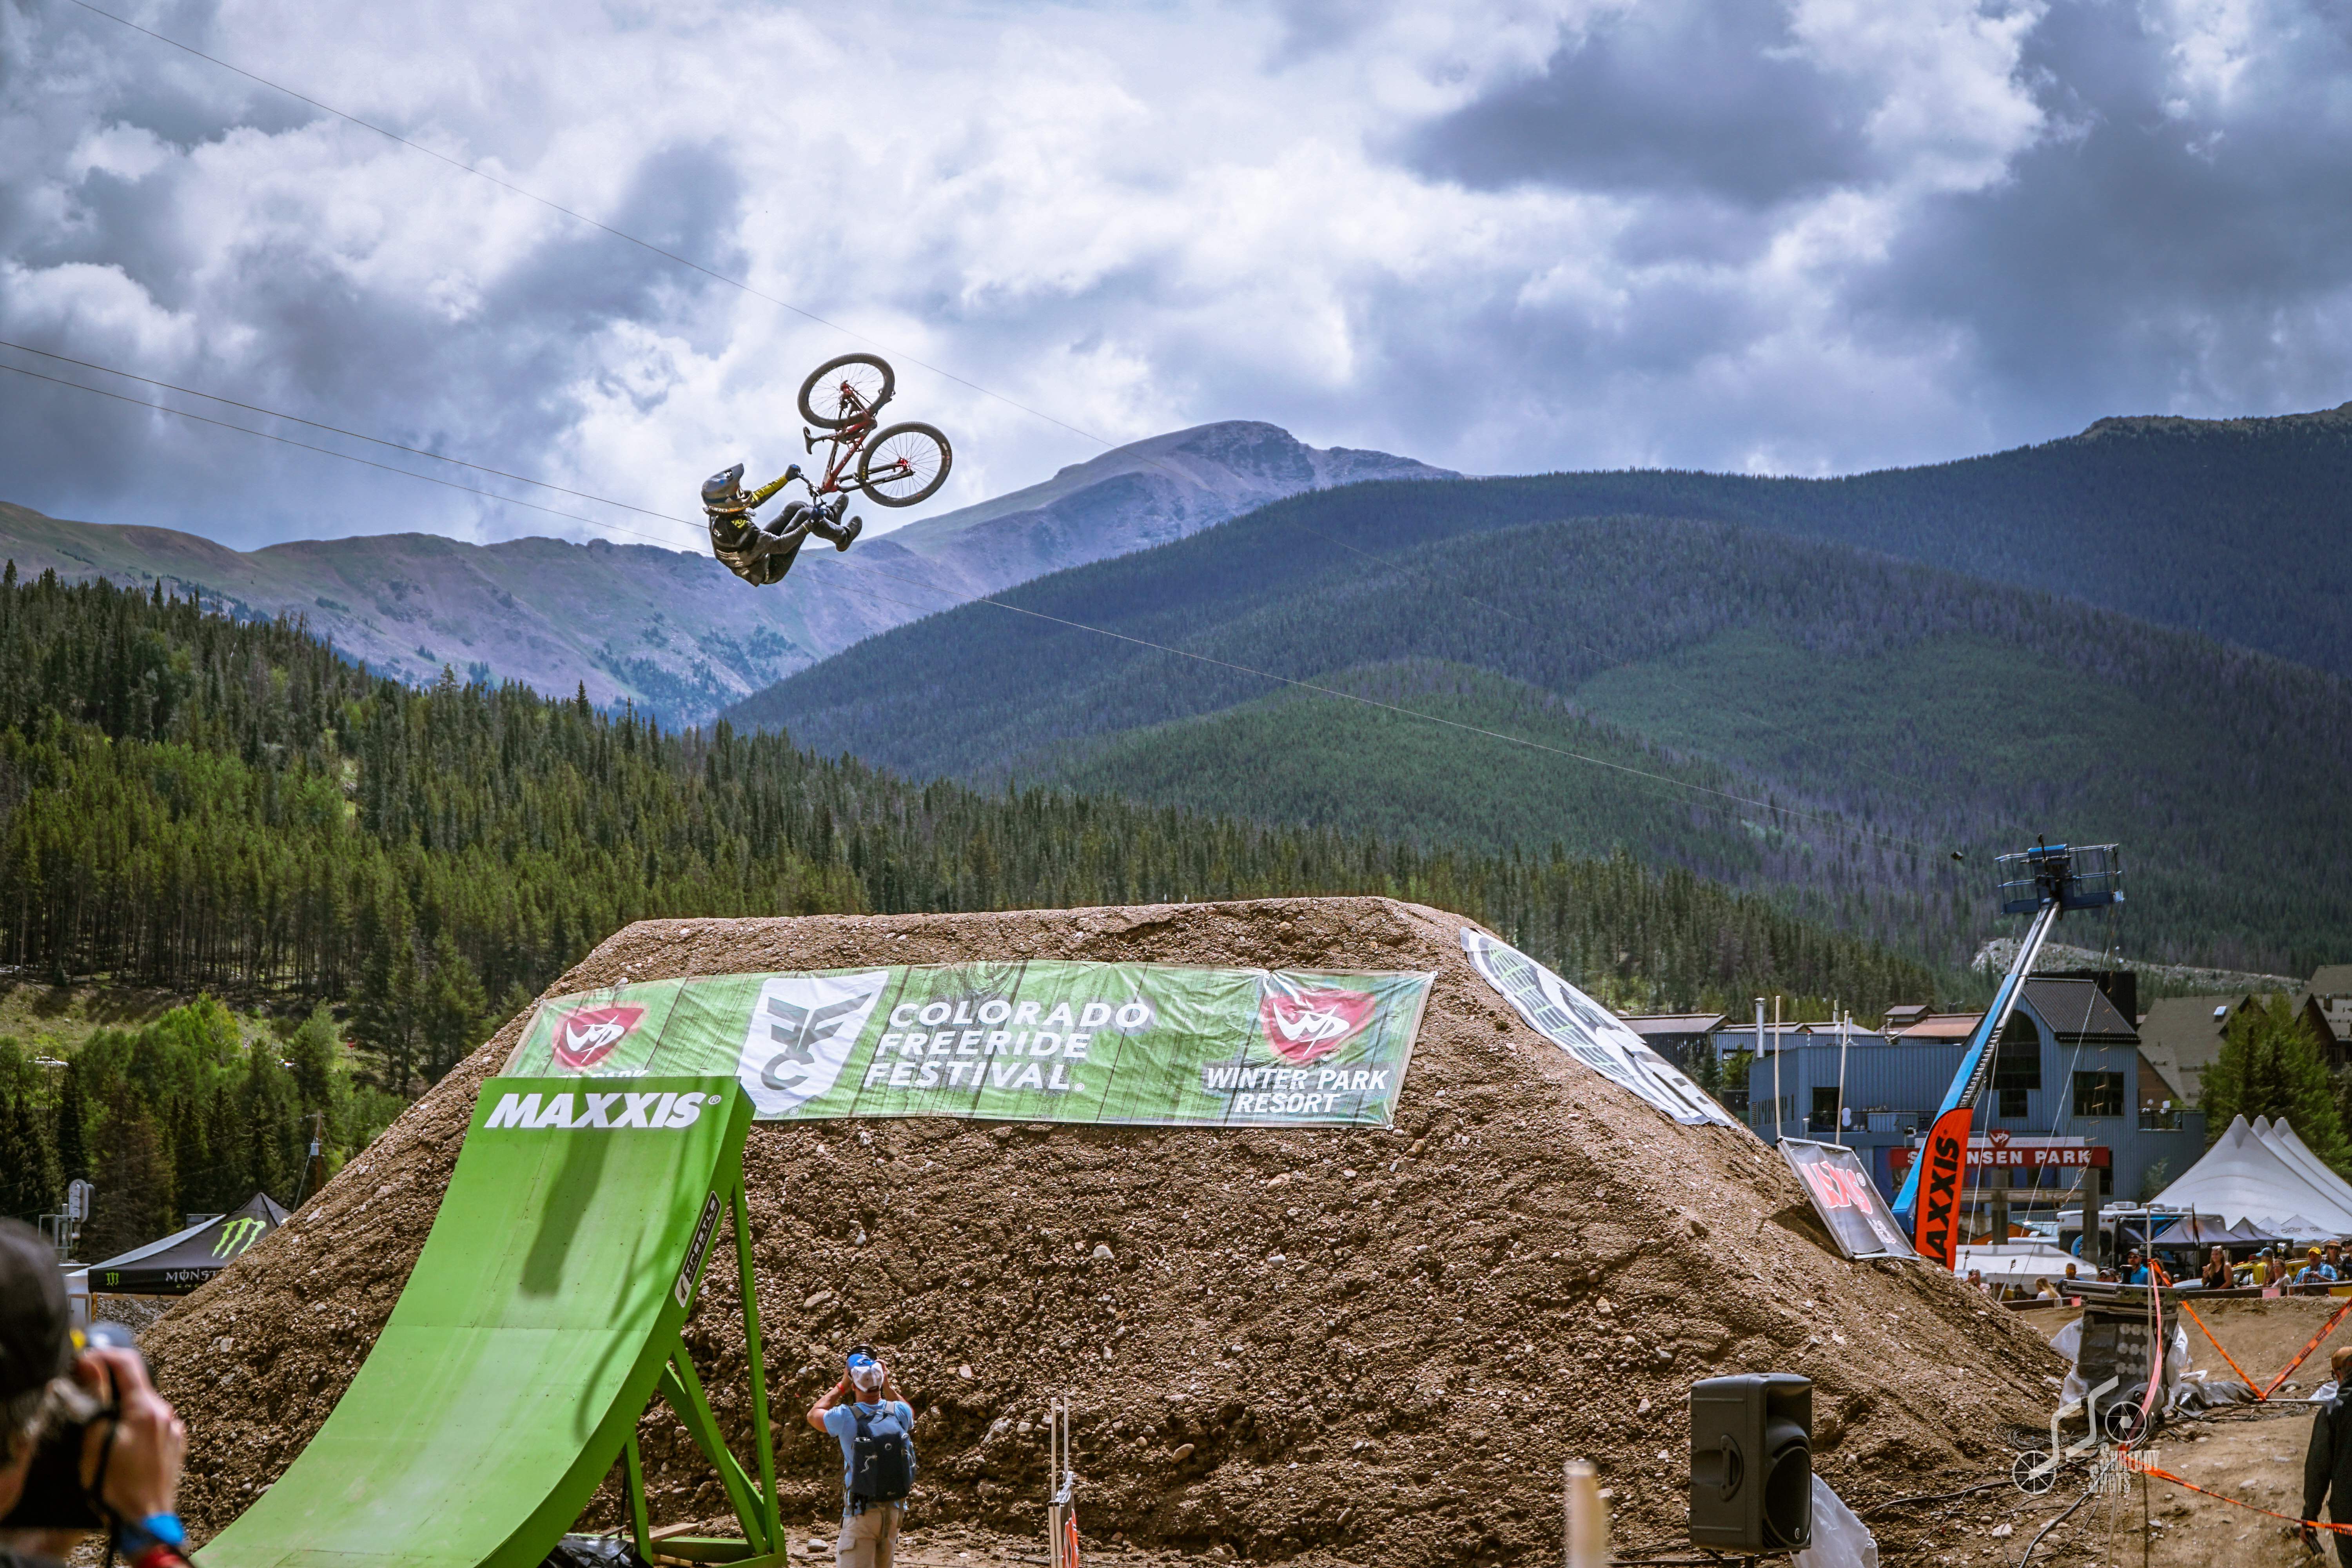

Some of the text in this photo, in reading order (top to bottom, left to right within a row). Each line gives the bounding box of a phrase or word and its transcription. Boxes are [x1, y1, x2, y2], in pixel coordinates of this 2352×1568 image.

[889, 1000, 1150, 1027] COLORADO
[875, 1030, 1091, 1058] FREERIDE
[863, 1060, 1070, 1090] FESTIVAL
[1208, 1067, 1390, 1091] WINTER PARK
[483, 1092, 707, 1129] MAXXIS
[1234, 1093, 1341, 1113] RESORT
[1907, 1150, 2092, 1165] SNSEN PARK
[686, 1199, 715, 1274] TRESTLE
[165, 1269, 219, 1282] MONST
